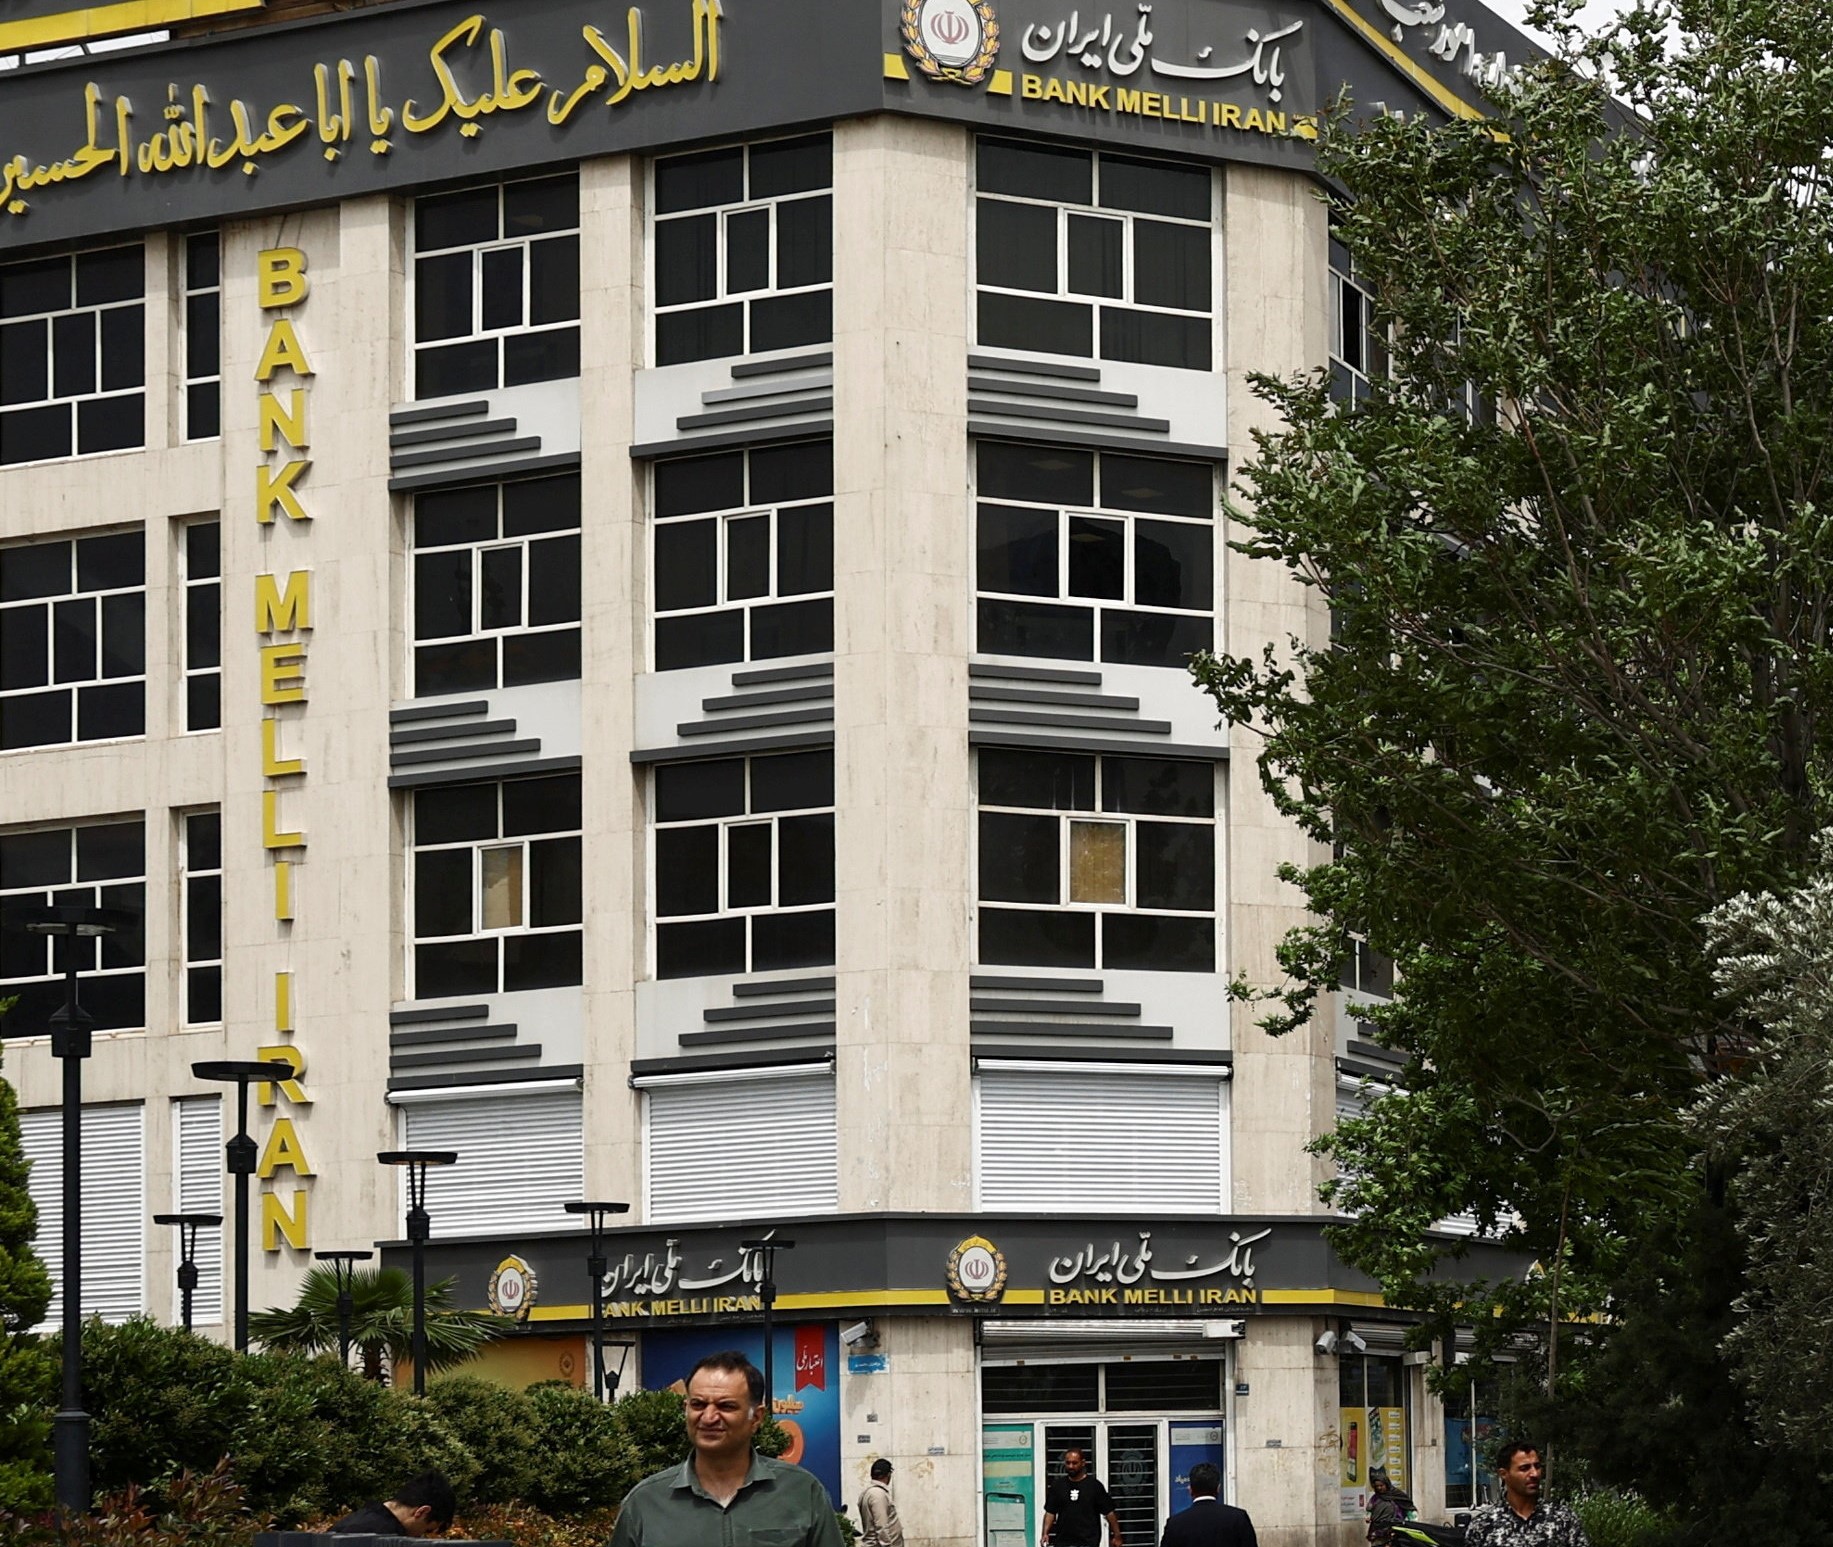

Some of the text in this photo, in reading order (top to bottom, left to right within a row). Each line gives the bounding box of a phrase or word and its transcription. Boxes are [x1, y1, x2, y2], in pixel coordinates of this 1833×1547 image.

[1021, 9, 1112, 69] ایران
[1021, 74, 1286, 134] BANK MELLI IRAN
[255, 246, 316, 1252] BANK MELLI IRAN
[1049, 1241, 1120, 1284] ایران
[601, 1294, 762, 1319] ANK MELLI IRAN
[1050, 1288, 1257, 1305] BANK MELLI IRAN
